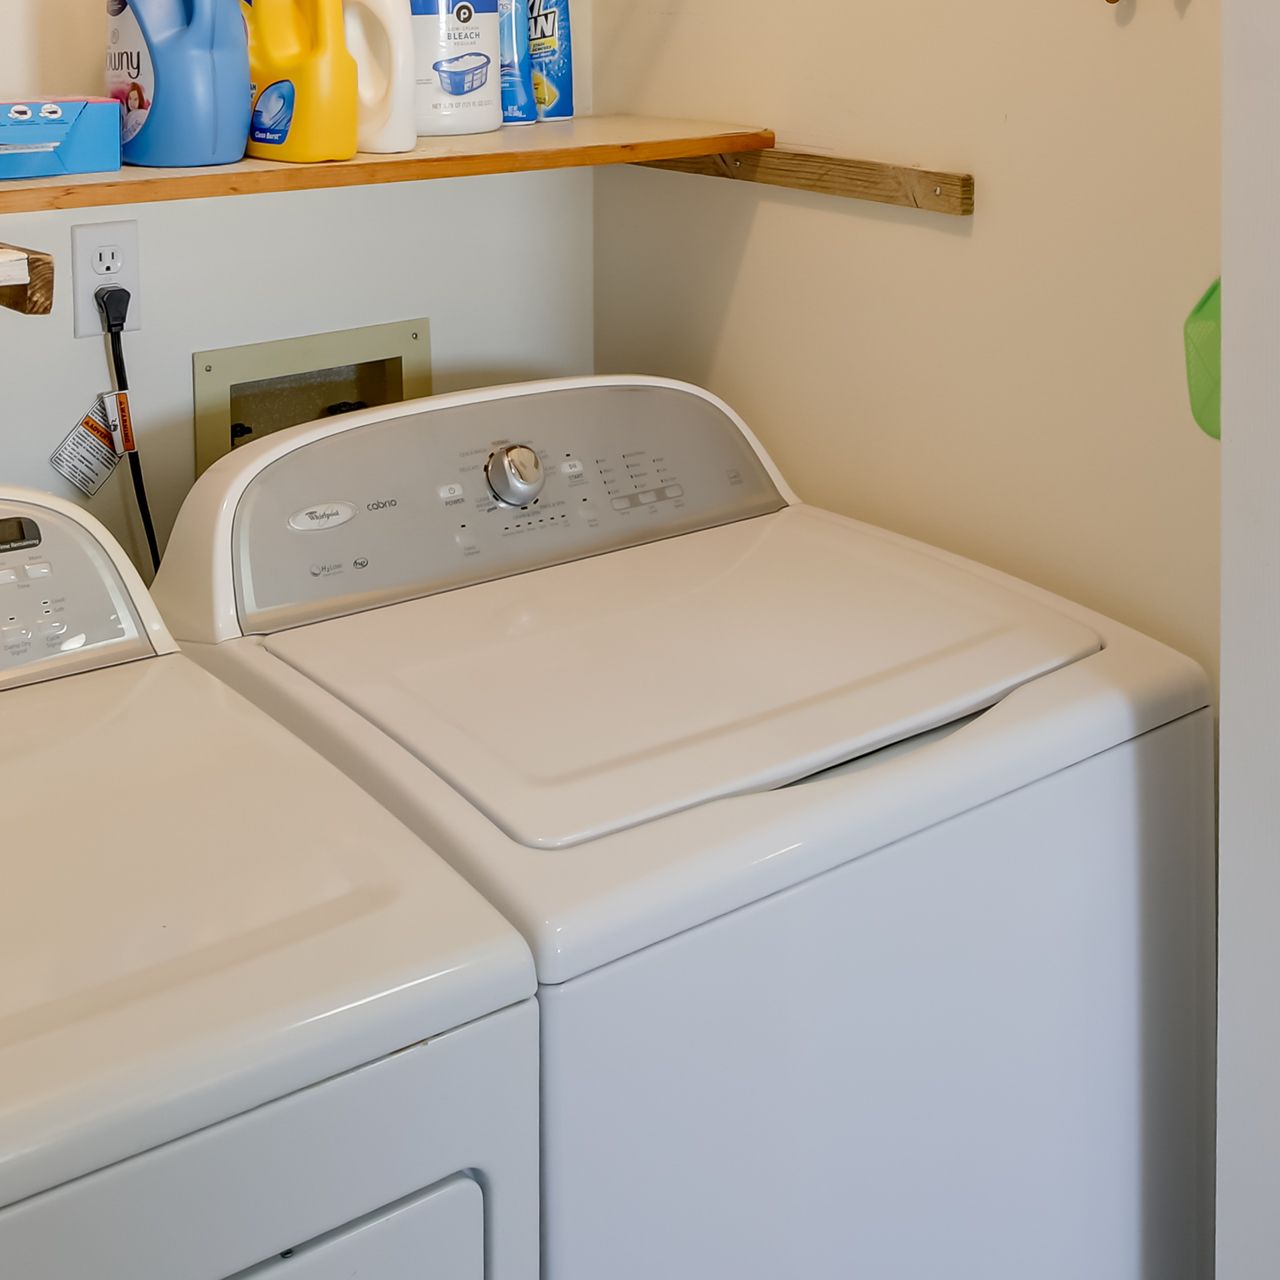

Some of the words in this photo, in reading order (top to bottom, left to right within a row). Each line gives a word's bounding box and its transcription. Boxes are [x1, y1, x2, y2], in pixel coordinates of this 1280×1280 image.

[447, 31, 480, 40] BLEACH
[367, 499, 397, 511] cabrio
[445, 498, 465, 506] POWER
[308, 510, 339, 520] Whirlpool
[11, 539, 39, 548] Remaining
